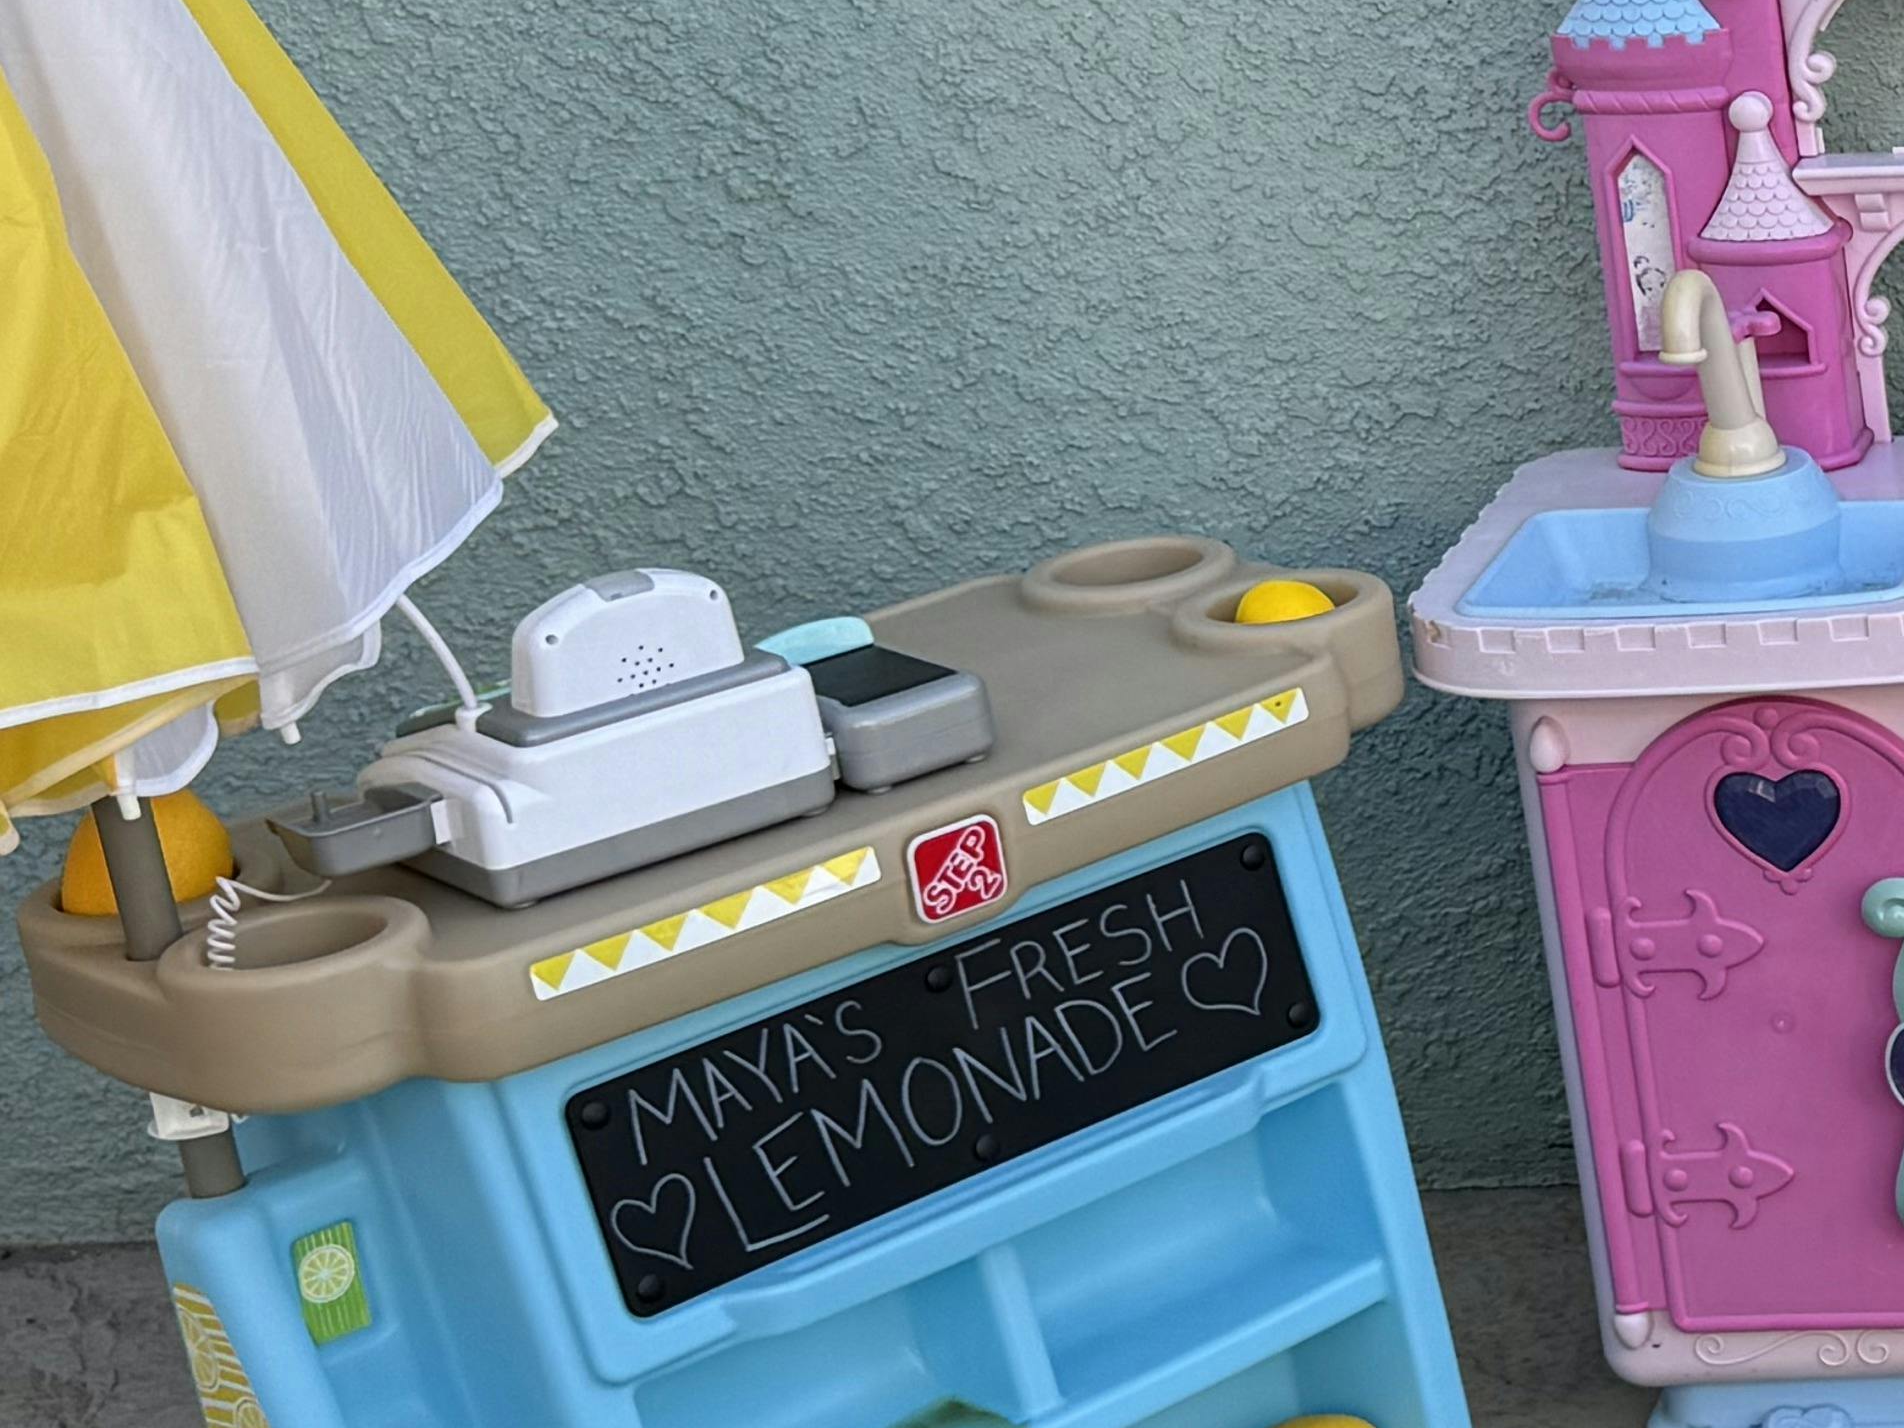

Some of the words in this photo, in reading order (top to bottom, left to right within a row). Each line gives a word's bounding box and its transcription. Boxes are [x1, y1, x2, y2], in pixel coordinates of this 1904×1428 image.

[923, 825, 986, 915] STEP
[966, 866, 1002, 900] 2
[627, 999, 883, 1166] MAYA'S
[954, 879, 1205, 1030] FRESH
[702, 971, 1178, 1253] LEMONADE
